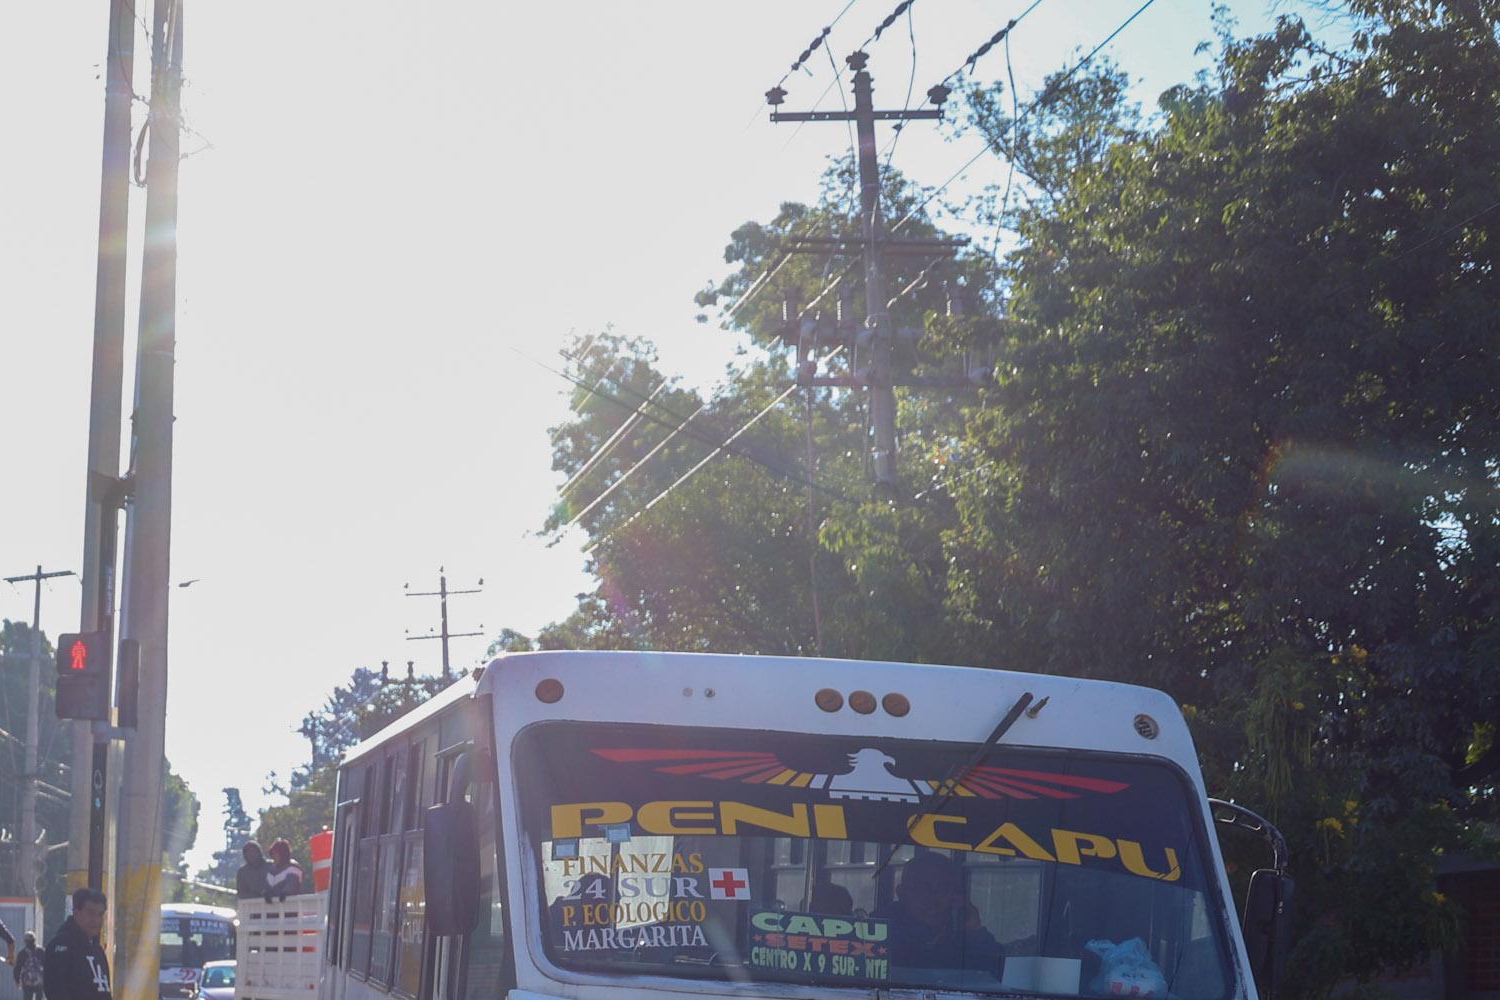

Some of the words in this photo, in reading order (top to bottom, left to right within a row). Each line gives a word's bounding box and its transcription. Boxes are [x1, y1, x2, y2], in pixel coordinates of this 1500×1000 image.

[551, 801, 848, 839] PENI
[907, 813, 1181, 881] CAPU
[562, 852, 705, 876] FINANZAS
[563, 879, 606, 900] 24
[621, 876, 705, 898] SUR
[563, 905, 577, 926] P.
[583, 900, 707, 925] ECOLOGICO
[563, 925, 708, 952] MARGARITA
[751, 912, 888, 941] CAPU
[764, 933, 876, 957] SETEX
[752, 947, 797, 969] CENTRO
[803, 952, 812, 972] X
[818, 952, 826, 973] 9
[866, 958, 887, 979] NTE
